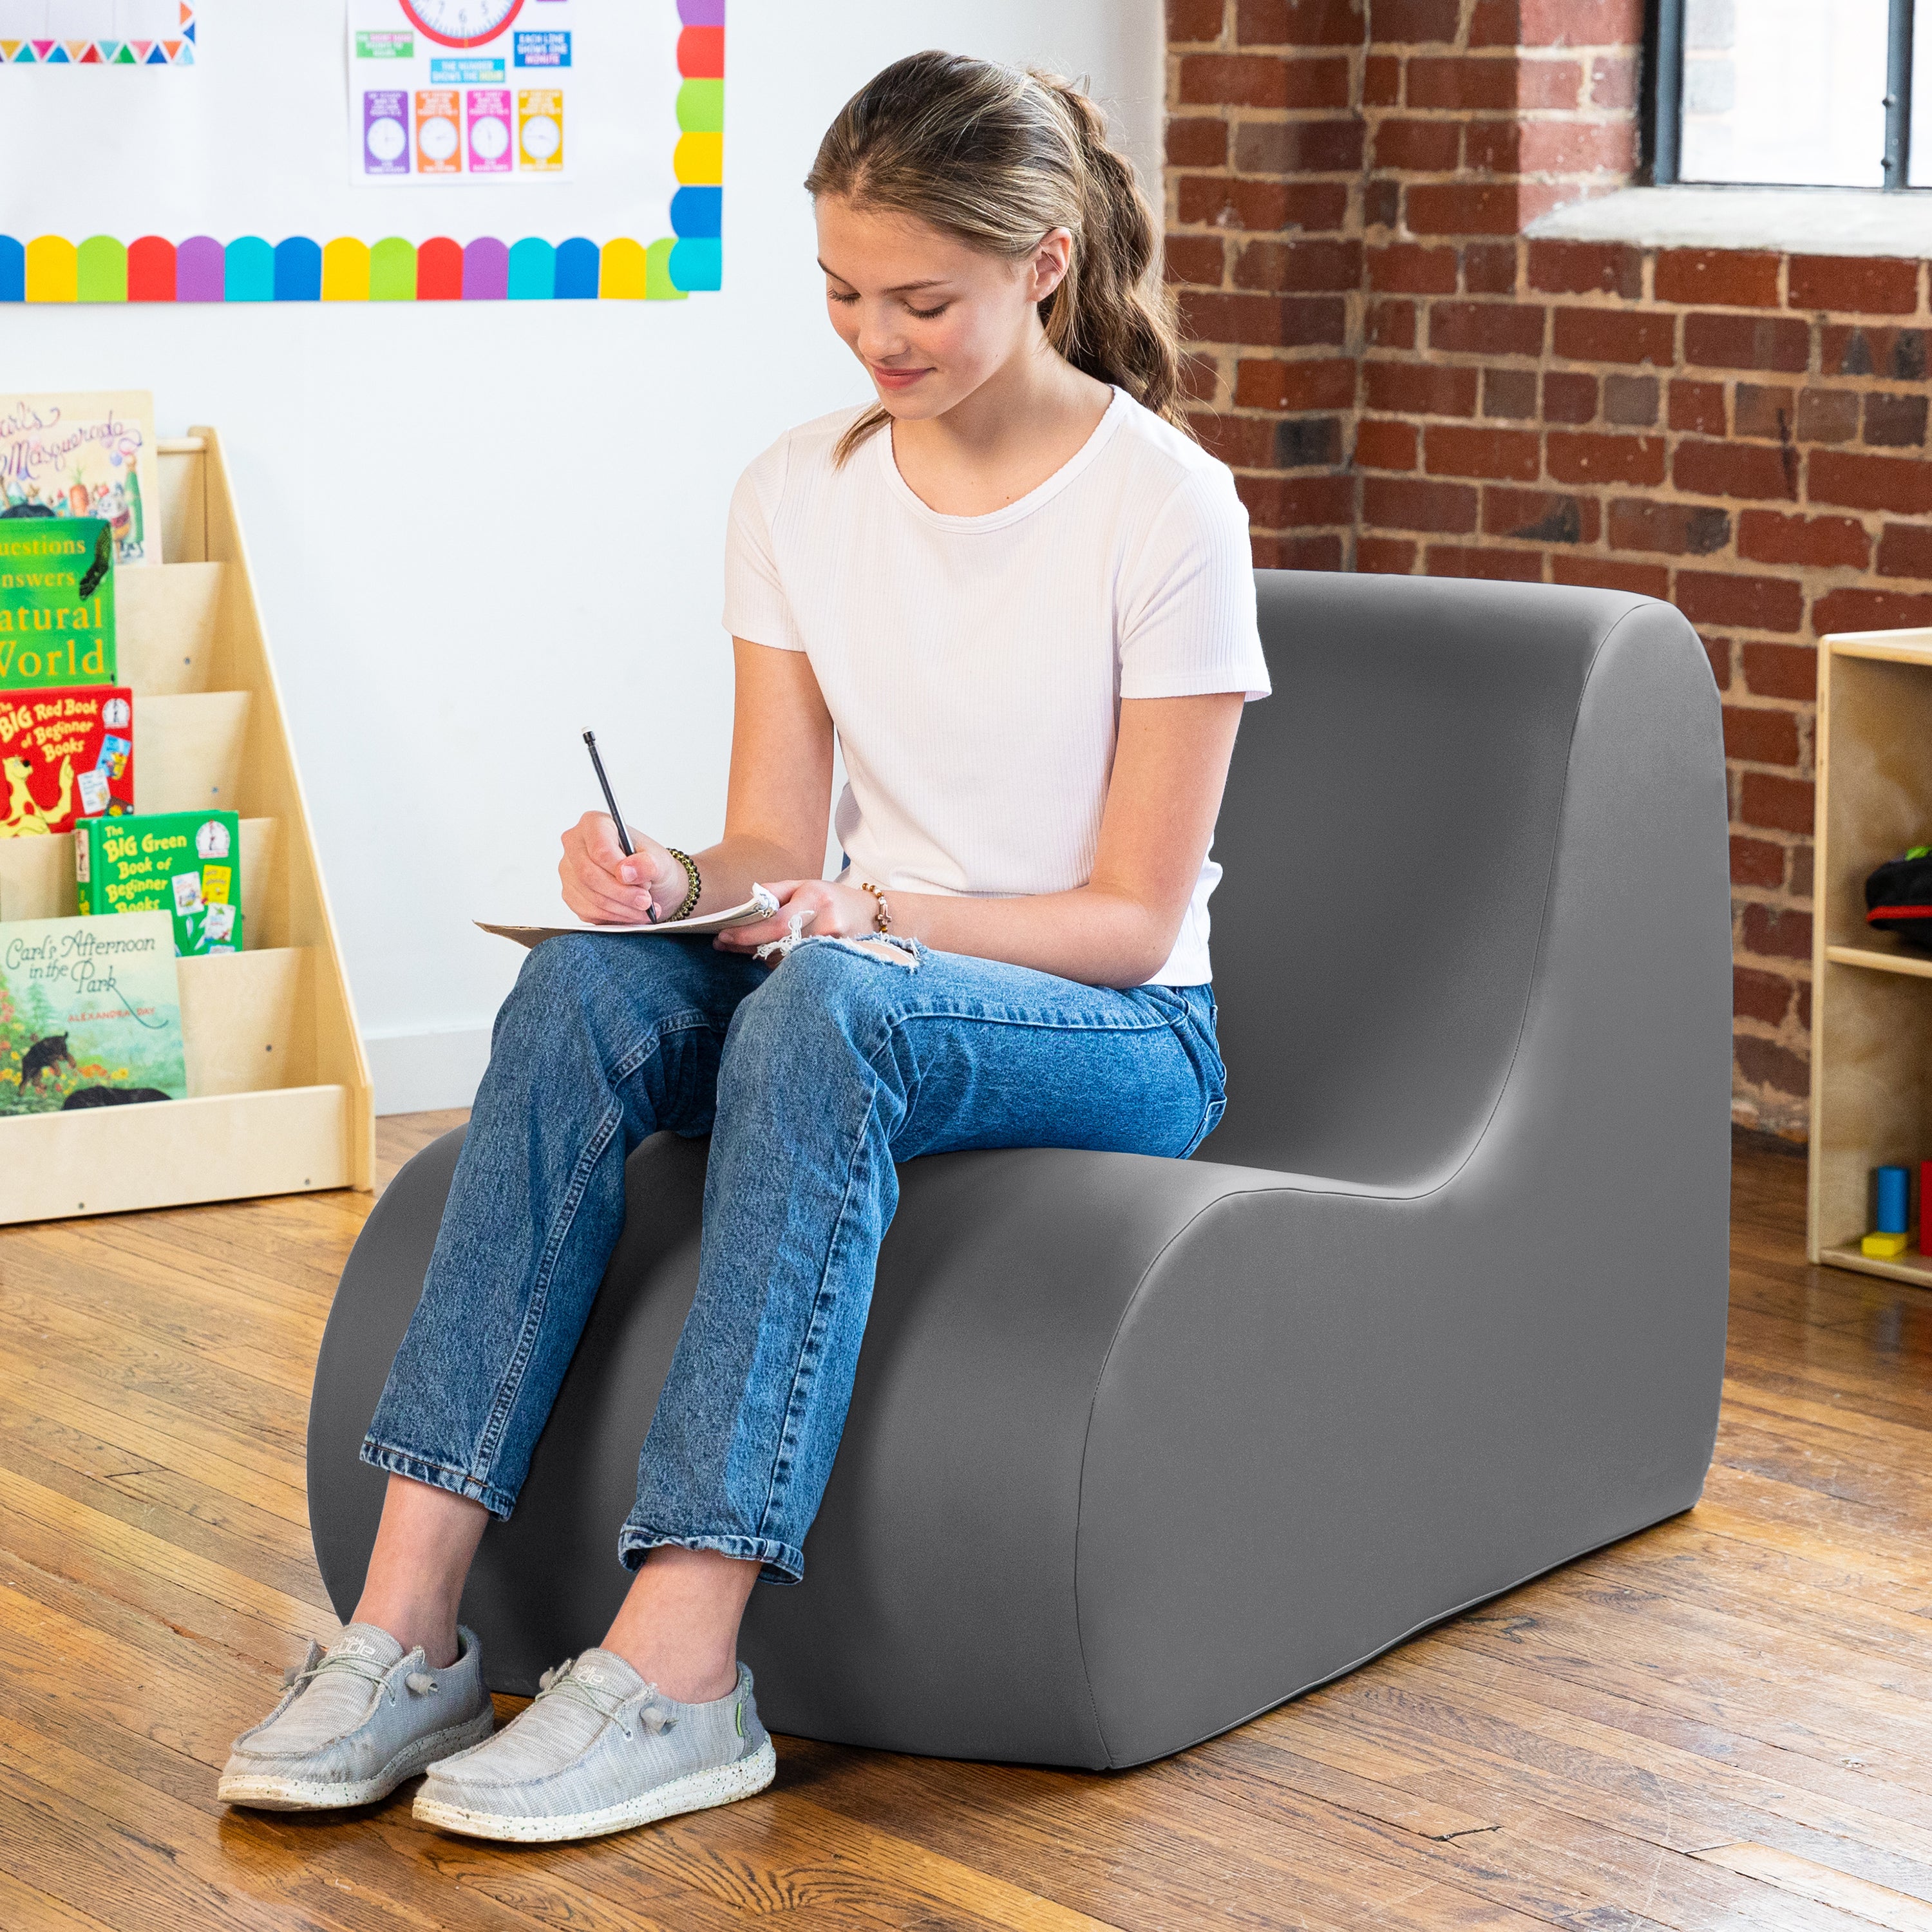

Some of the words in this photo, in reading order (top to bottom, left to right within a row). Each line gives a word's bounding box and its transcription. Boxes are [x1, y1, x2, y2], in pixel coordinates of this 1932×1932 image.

[0, 401, 61, 438] arl's
[0, 535, 86, 556] uestions
[1, 572, 75, 589] nswers
[0, 598, 102, 631] atural
[0, 701, 14, 714] he
[0, 705, 34, 743] BIG
[33, 699, 62, 721] Red
[64, 698, 98, 716] Book
[21, 732, 32, 748] of
[33, 721, 94, 746] Beginner
[41, 737, 85, 763] Books
[105, 826, 124, 838] The
[102, 835, 138, 864] BIG
[141, 833, 187, 853] Green
[117, 857, 153, 880] Book
[156, 857, 173, 871] of
[105, 879, 169, 903] Beginner
[5, 934, 57, 970] Carl's
[61, 929, 156, 958] Afternoon
[30, 963, 43, 979] in
[46, 959, 70, 982] the
[68, 1009, 130, 1023] ALEXANDRA
[137, 1007, 156, 1017] DAY
